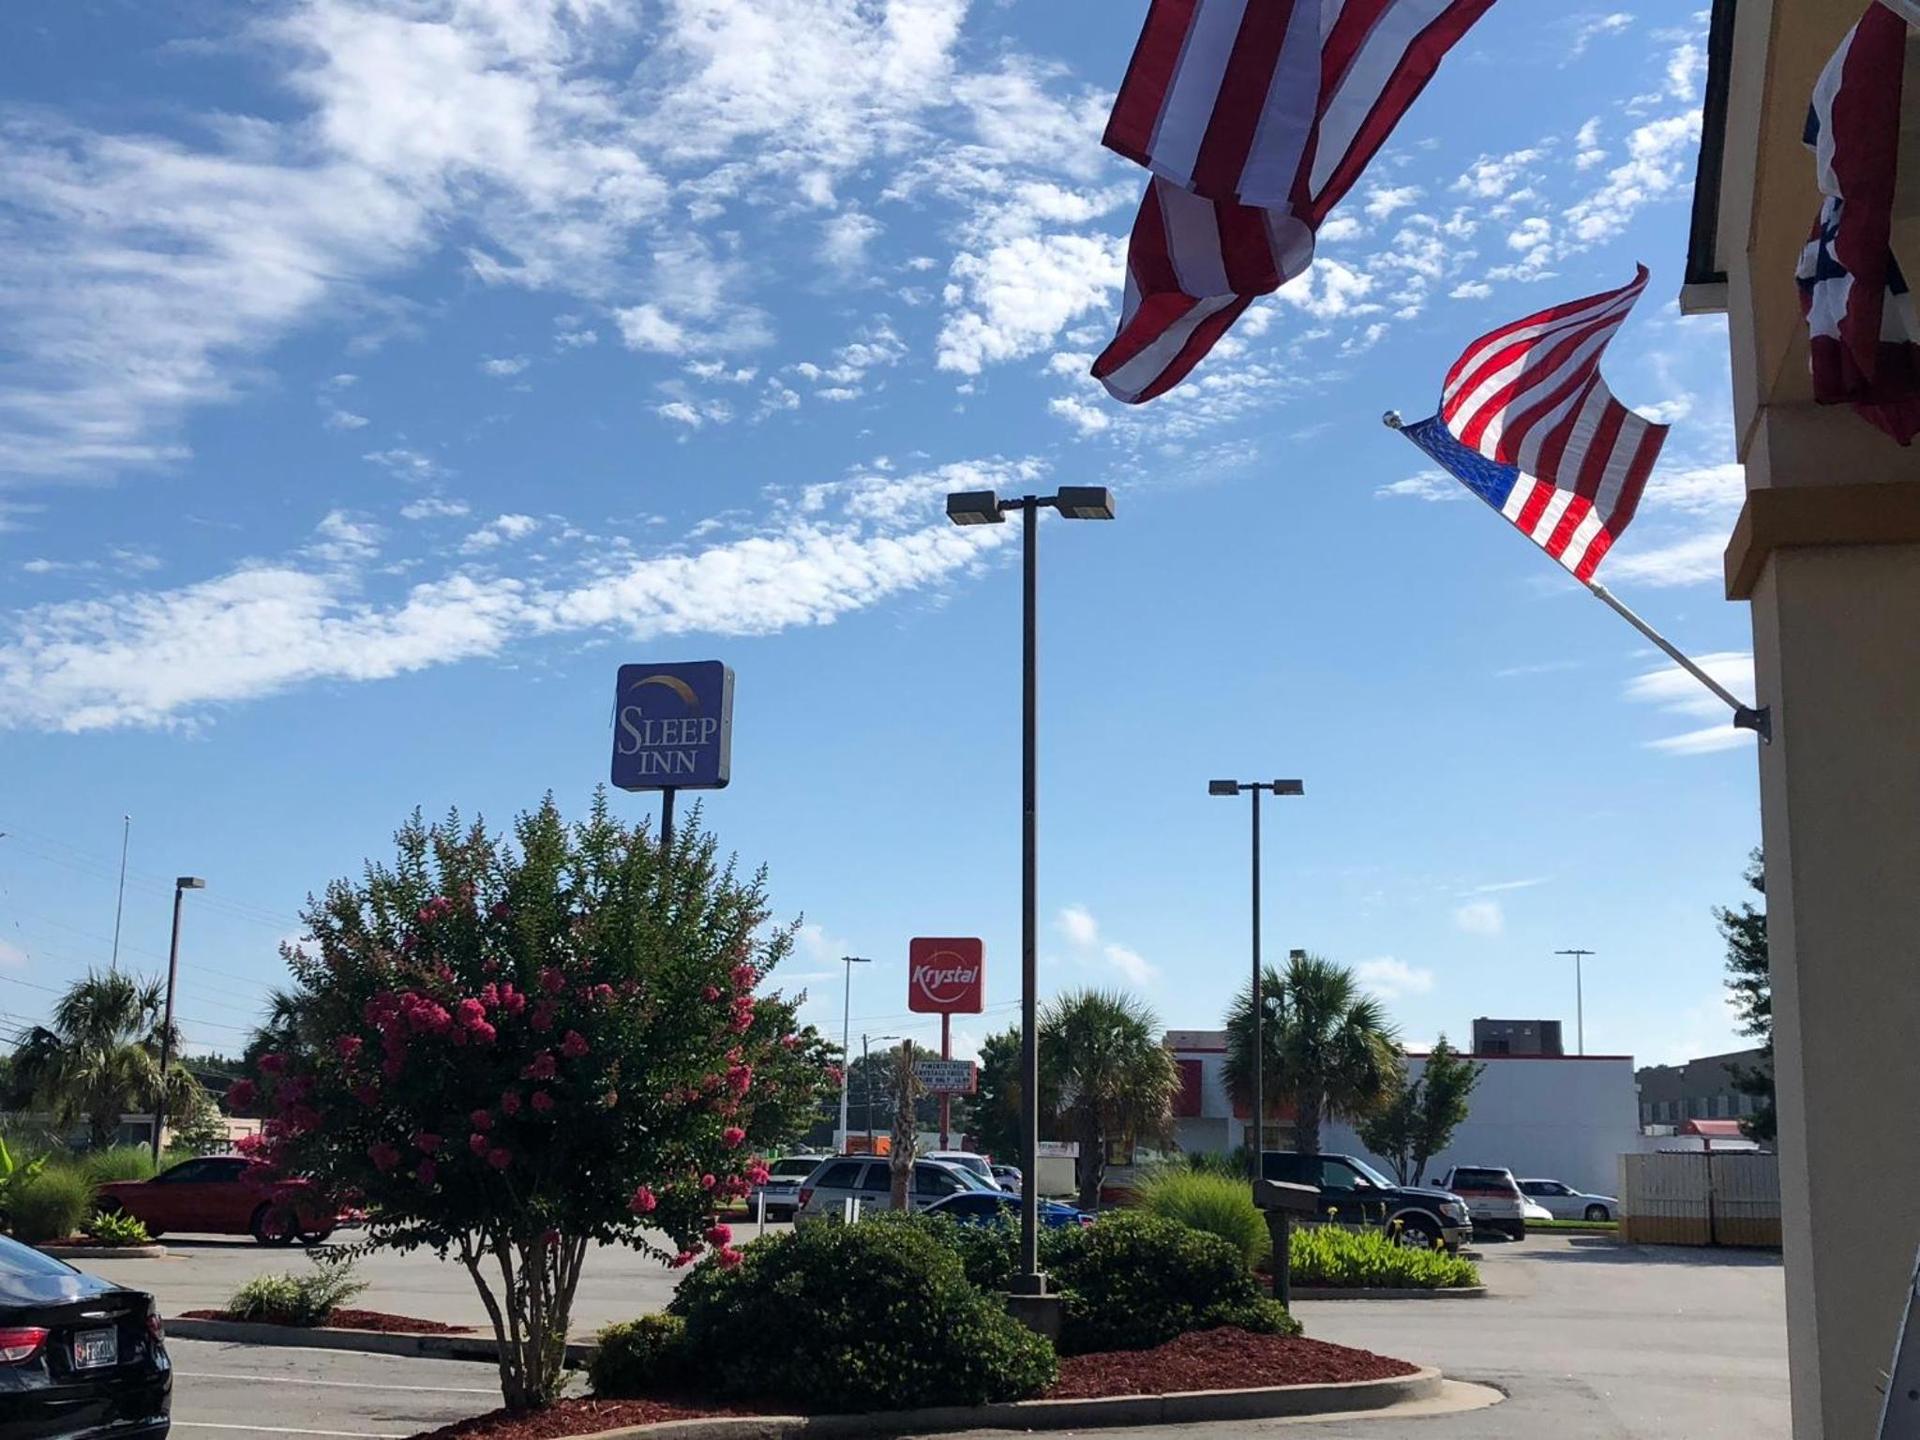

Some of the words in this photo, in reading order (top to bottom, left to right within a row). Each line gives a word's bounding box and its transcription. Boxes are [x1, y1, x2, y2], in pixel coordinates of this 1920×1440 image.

[618, 705, 718, 755] SLEEP
[638, 750, 698, 775] INN
[912, 965, 979, 989] Krystal
